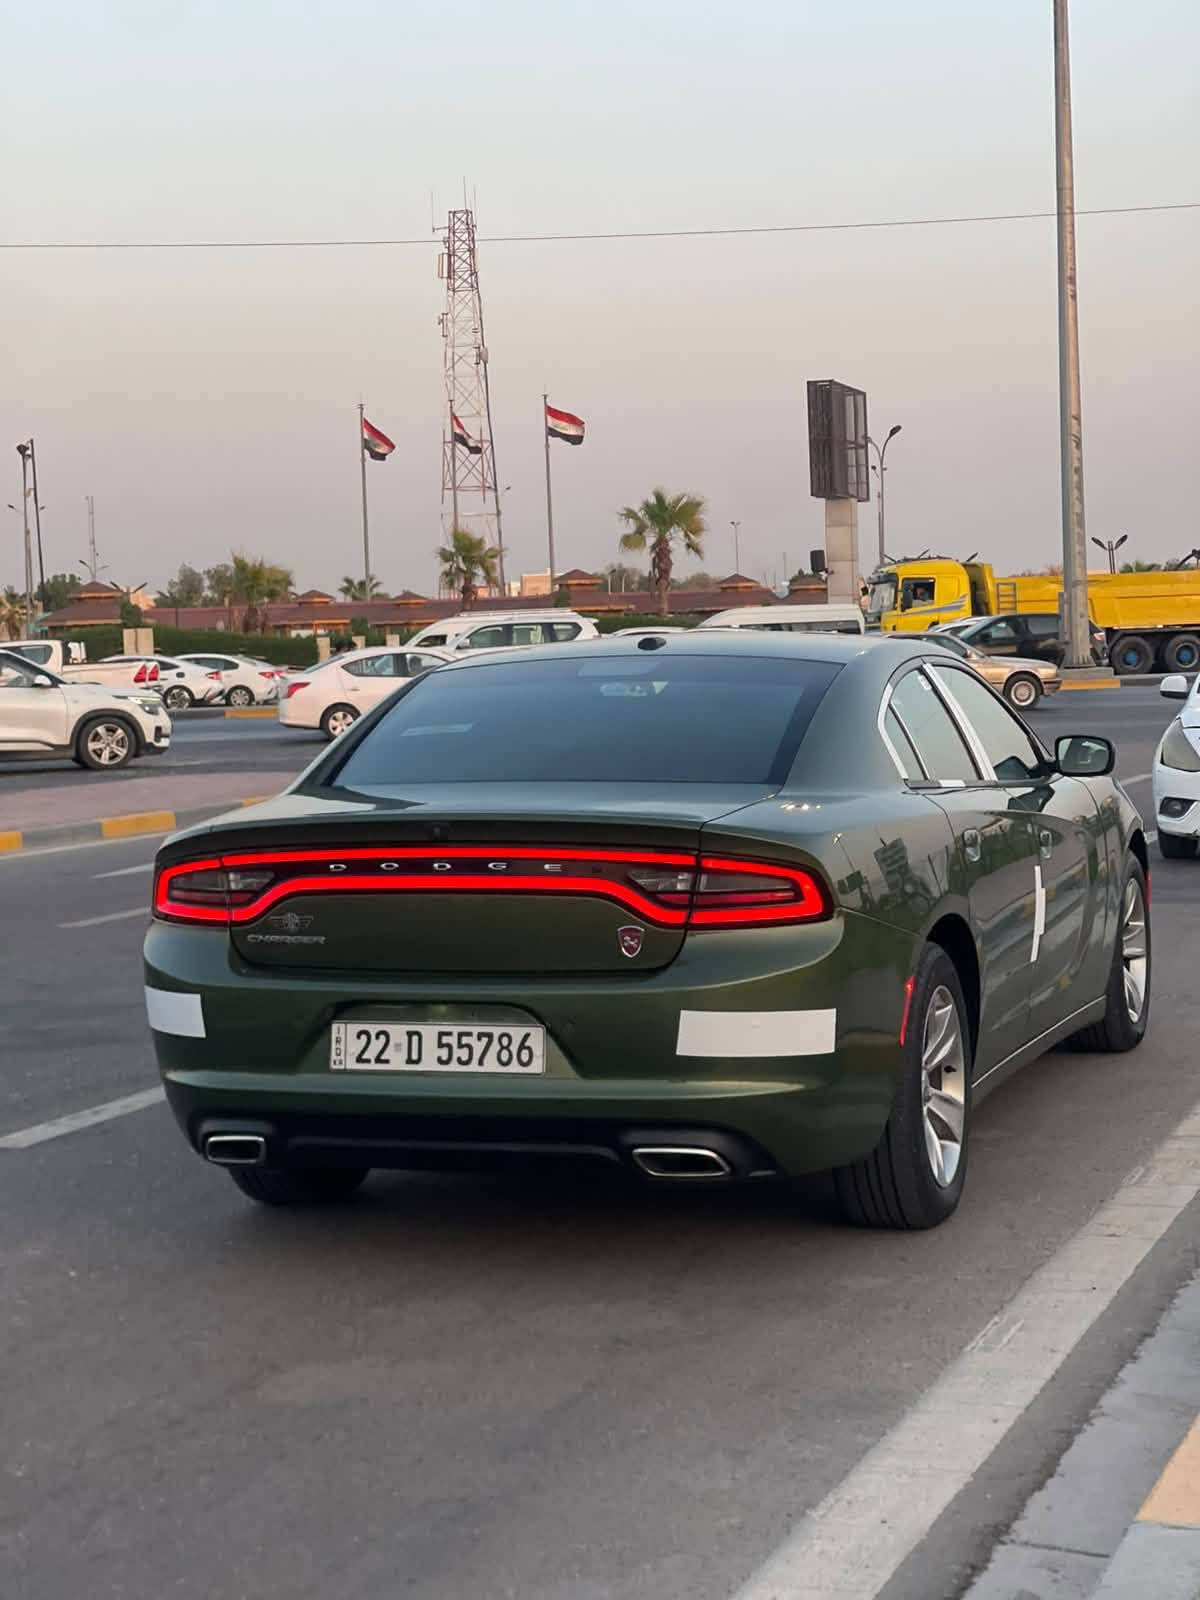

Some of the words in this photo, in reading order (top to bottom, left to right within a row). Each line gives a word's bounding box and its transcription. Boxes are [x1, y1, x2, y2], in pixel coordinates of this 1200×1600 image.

[329, 862, 562, 872] DODGE
[355, 1030, 391, 1064] 22
[405, 1030, 423, 1065] D
[436, 1031, 534, 1067] 55786
